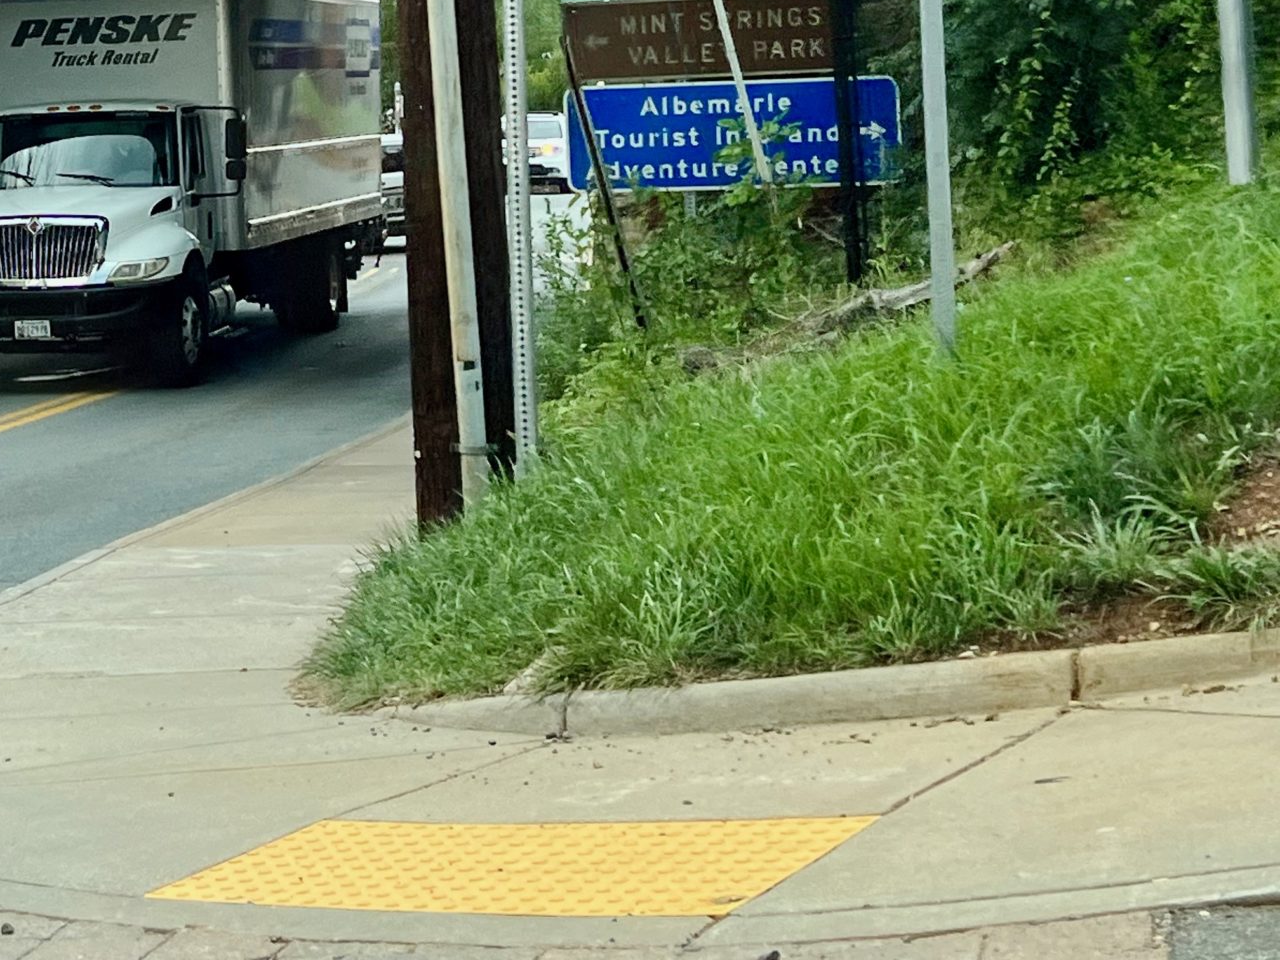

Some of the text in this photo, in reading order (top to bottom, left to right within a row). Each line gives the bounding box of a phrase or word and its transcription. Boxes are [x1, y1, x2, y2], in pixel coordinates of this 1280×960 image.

[10, 13, 197, 47] PENSKE
[621, 7, 821, 35] MINT SRINGS
[52, 48, 159, 67] Truck Rental
[754, 38, 825, 60] PARK
[595, 126, 699, 149] Tourist
